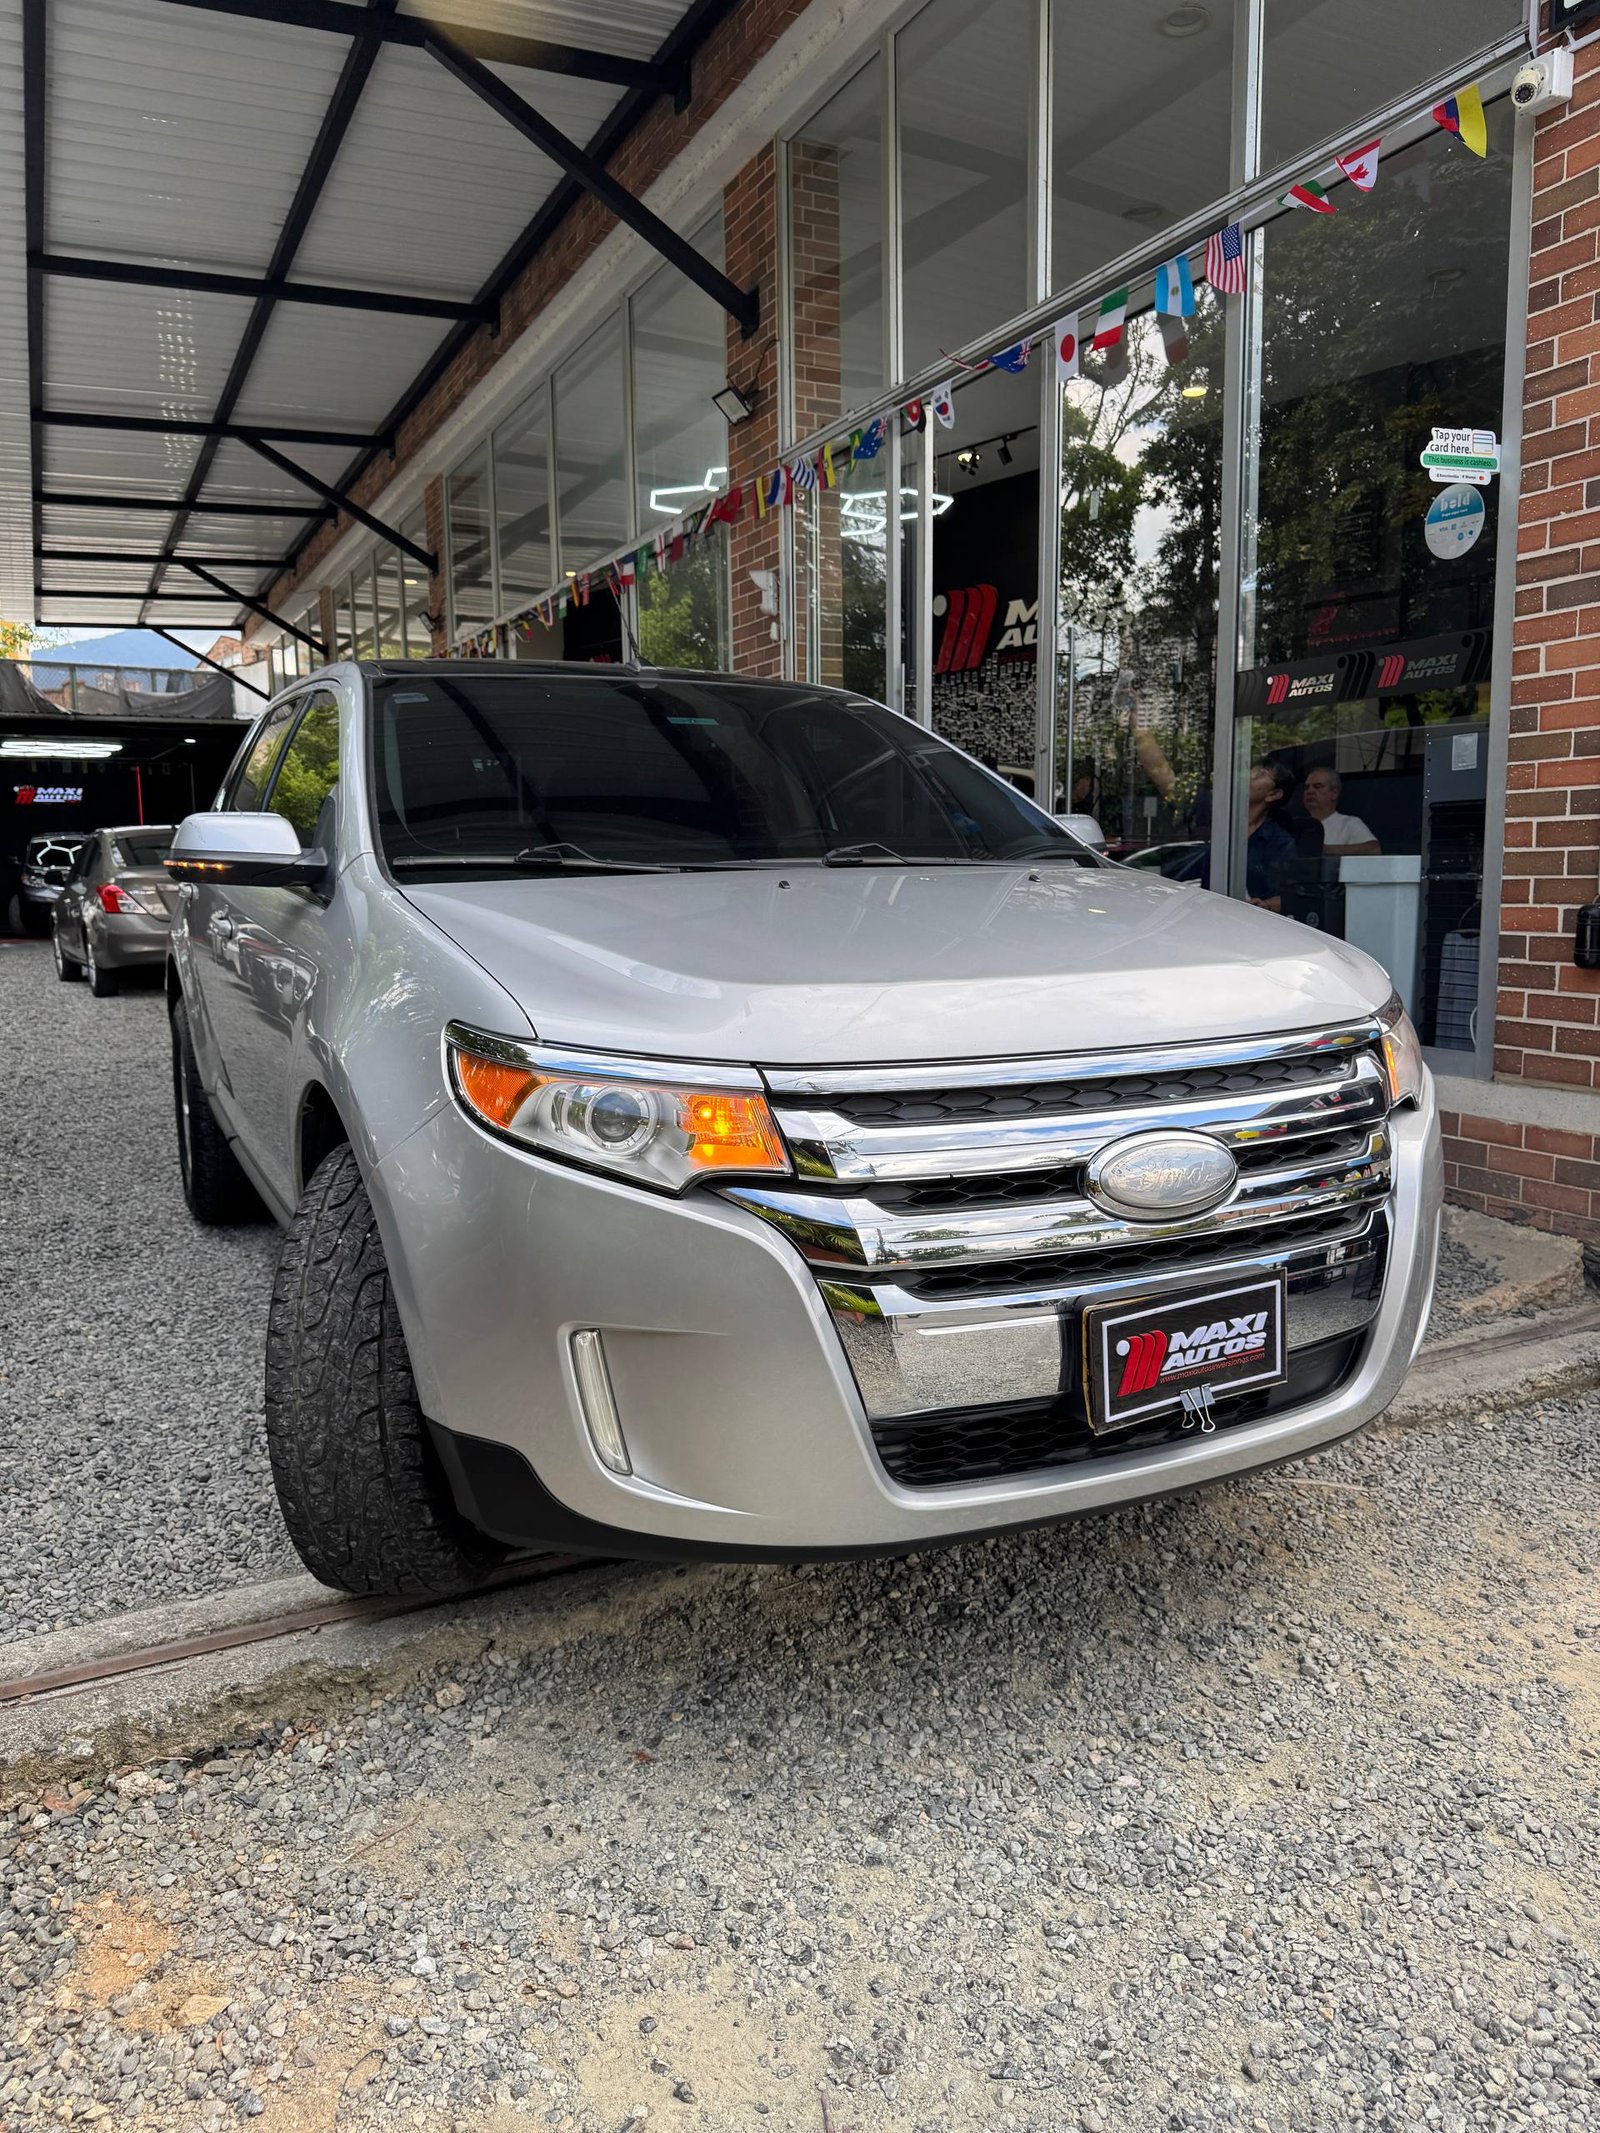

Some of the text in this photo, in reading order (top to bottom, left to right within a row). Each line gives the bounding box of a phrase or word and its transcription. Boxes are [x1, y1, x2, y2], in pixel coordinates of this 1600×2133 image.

[1435, 430, 1471, 443] Tap your
[1430, 443, 1472, 454] card here.
[1428, 456, 1440, 464] This
[1441, 457, 1464, 466] business
[1470, 458, 1493, 467] cashless.
[1440, 492, 1470, 512] bold
[1407, 654, 1459, 671] MAXI
[1403, 664, 1457, 680] AUTOS
[1291, 673, 1335, 689] MAXI
[1288, 683, 1334, 698] AUTOS
[36, 787, 83, 795] MAXI
[1168, 1311, 1268, 1353] MAXI
[1161, 1332, 1267, 1372] AUTOS
